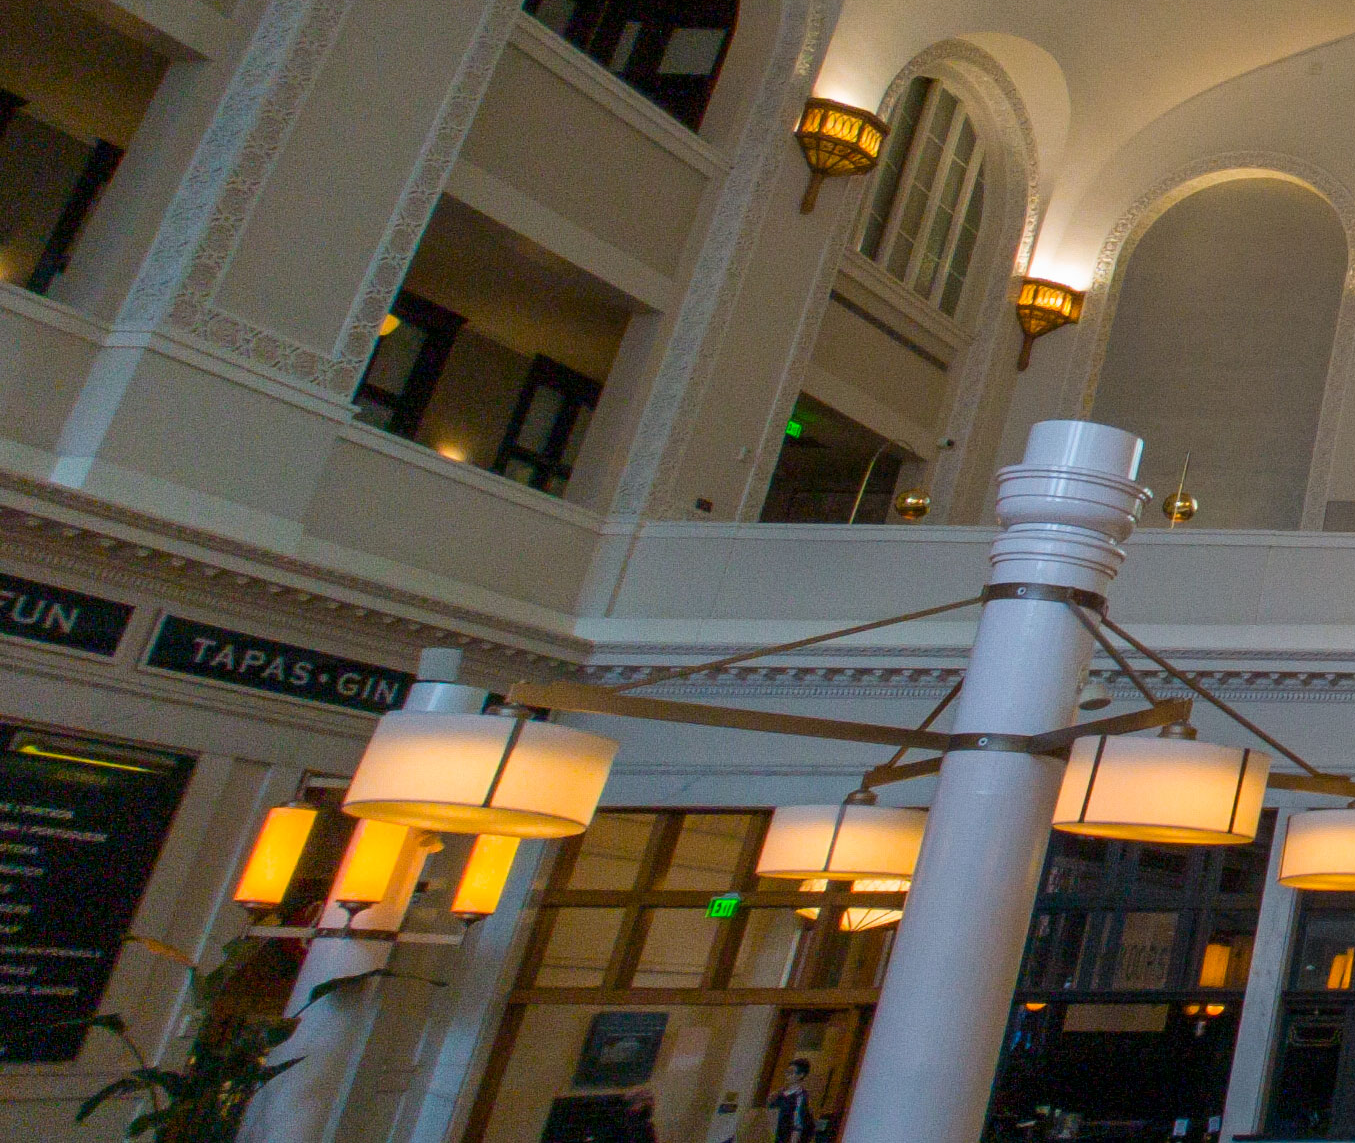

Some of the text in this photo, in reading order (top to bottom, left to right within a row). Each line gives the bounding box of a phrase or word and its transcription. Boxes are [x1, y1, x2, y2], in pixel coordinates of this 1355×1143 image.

[192, 637, 399, 705] TAPAS GIN
[711, 899, 738, 917] EXIT
